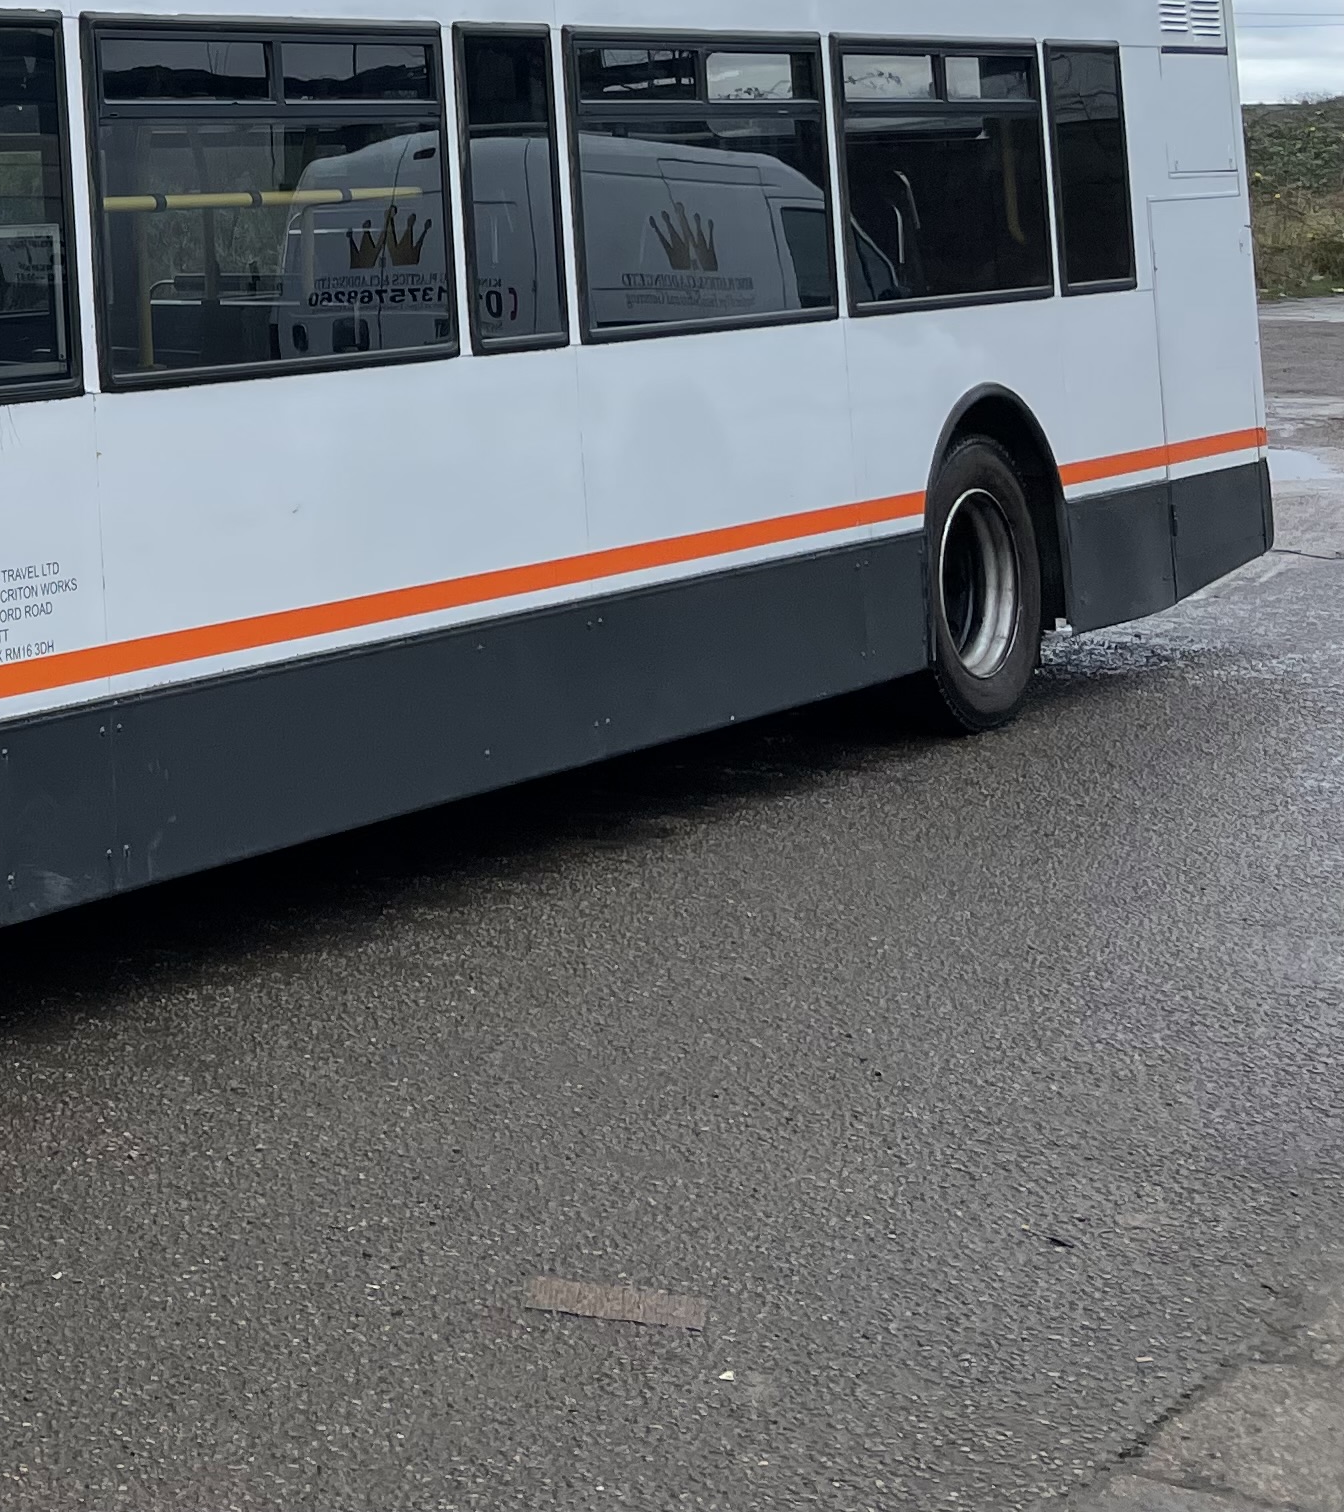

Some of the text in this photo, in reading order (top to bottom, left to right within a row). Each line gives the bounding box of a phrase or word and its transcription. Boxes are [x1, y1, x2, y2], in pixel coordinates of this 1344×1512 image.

[1, 565, 40, 584] TRAVEL
[41, 561, 60, 577] LTD
[0, 585, 38, 604] CRITON
[40, 577, 78, 597] WORKS
[24, 601, 53, 620] ROAD
[5, 644, 33, 661] RM16
[34, 639, 55, 657] 3DH
